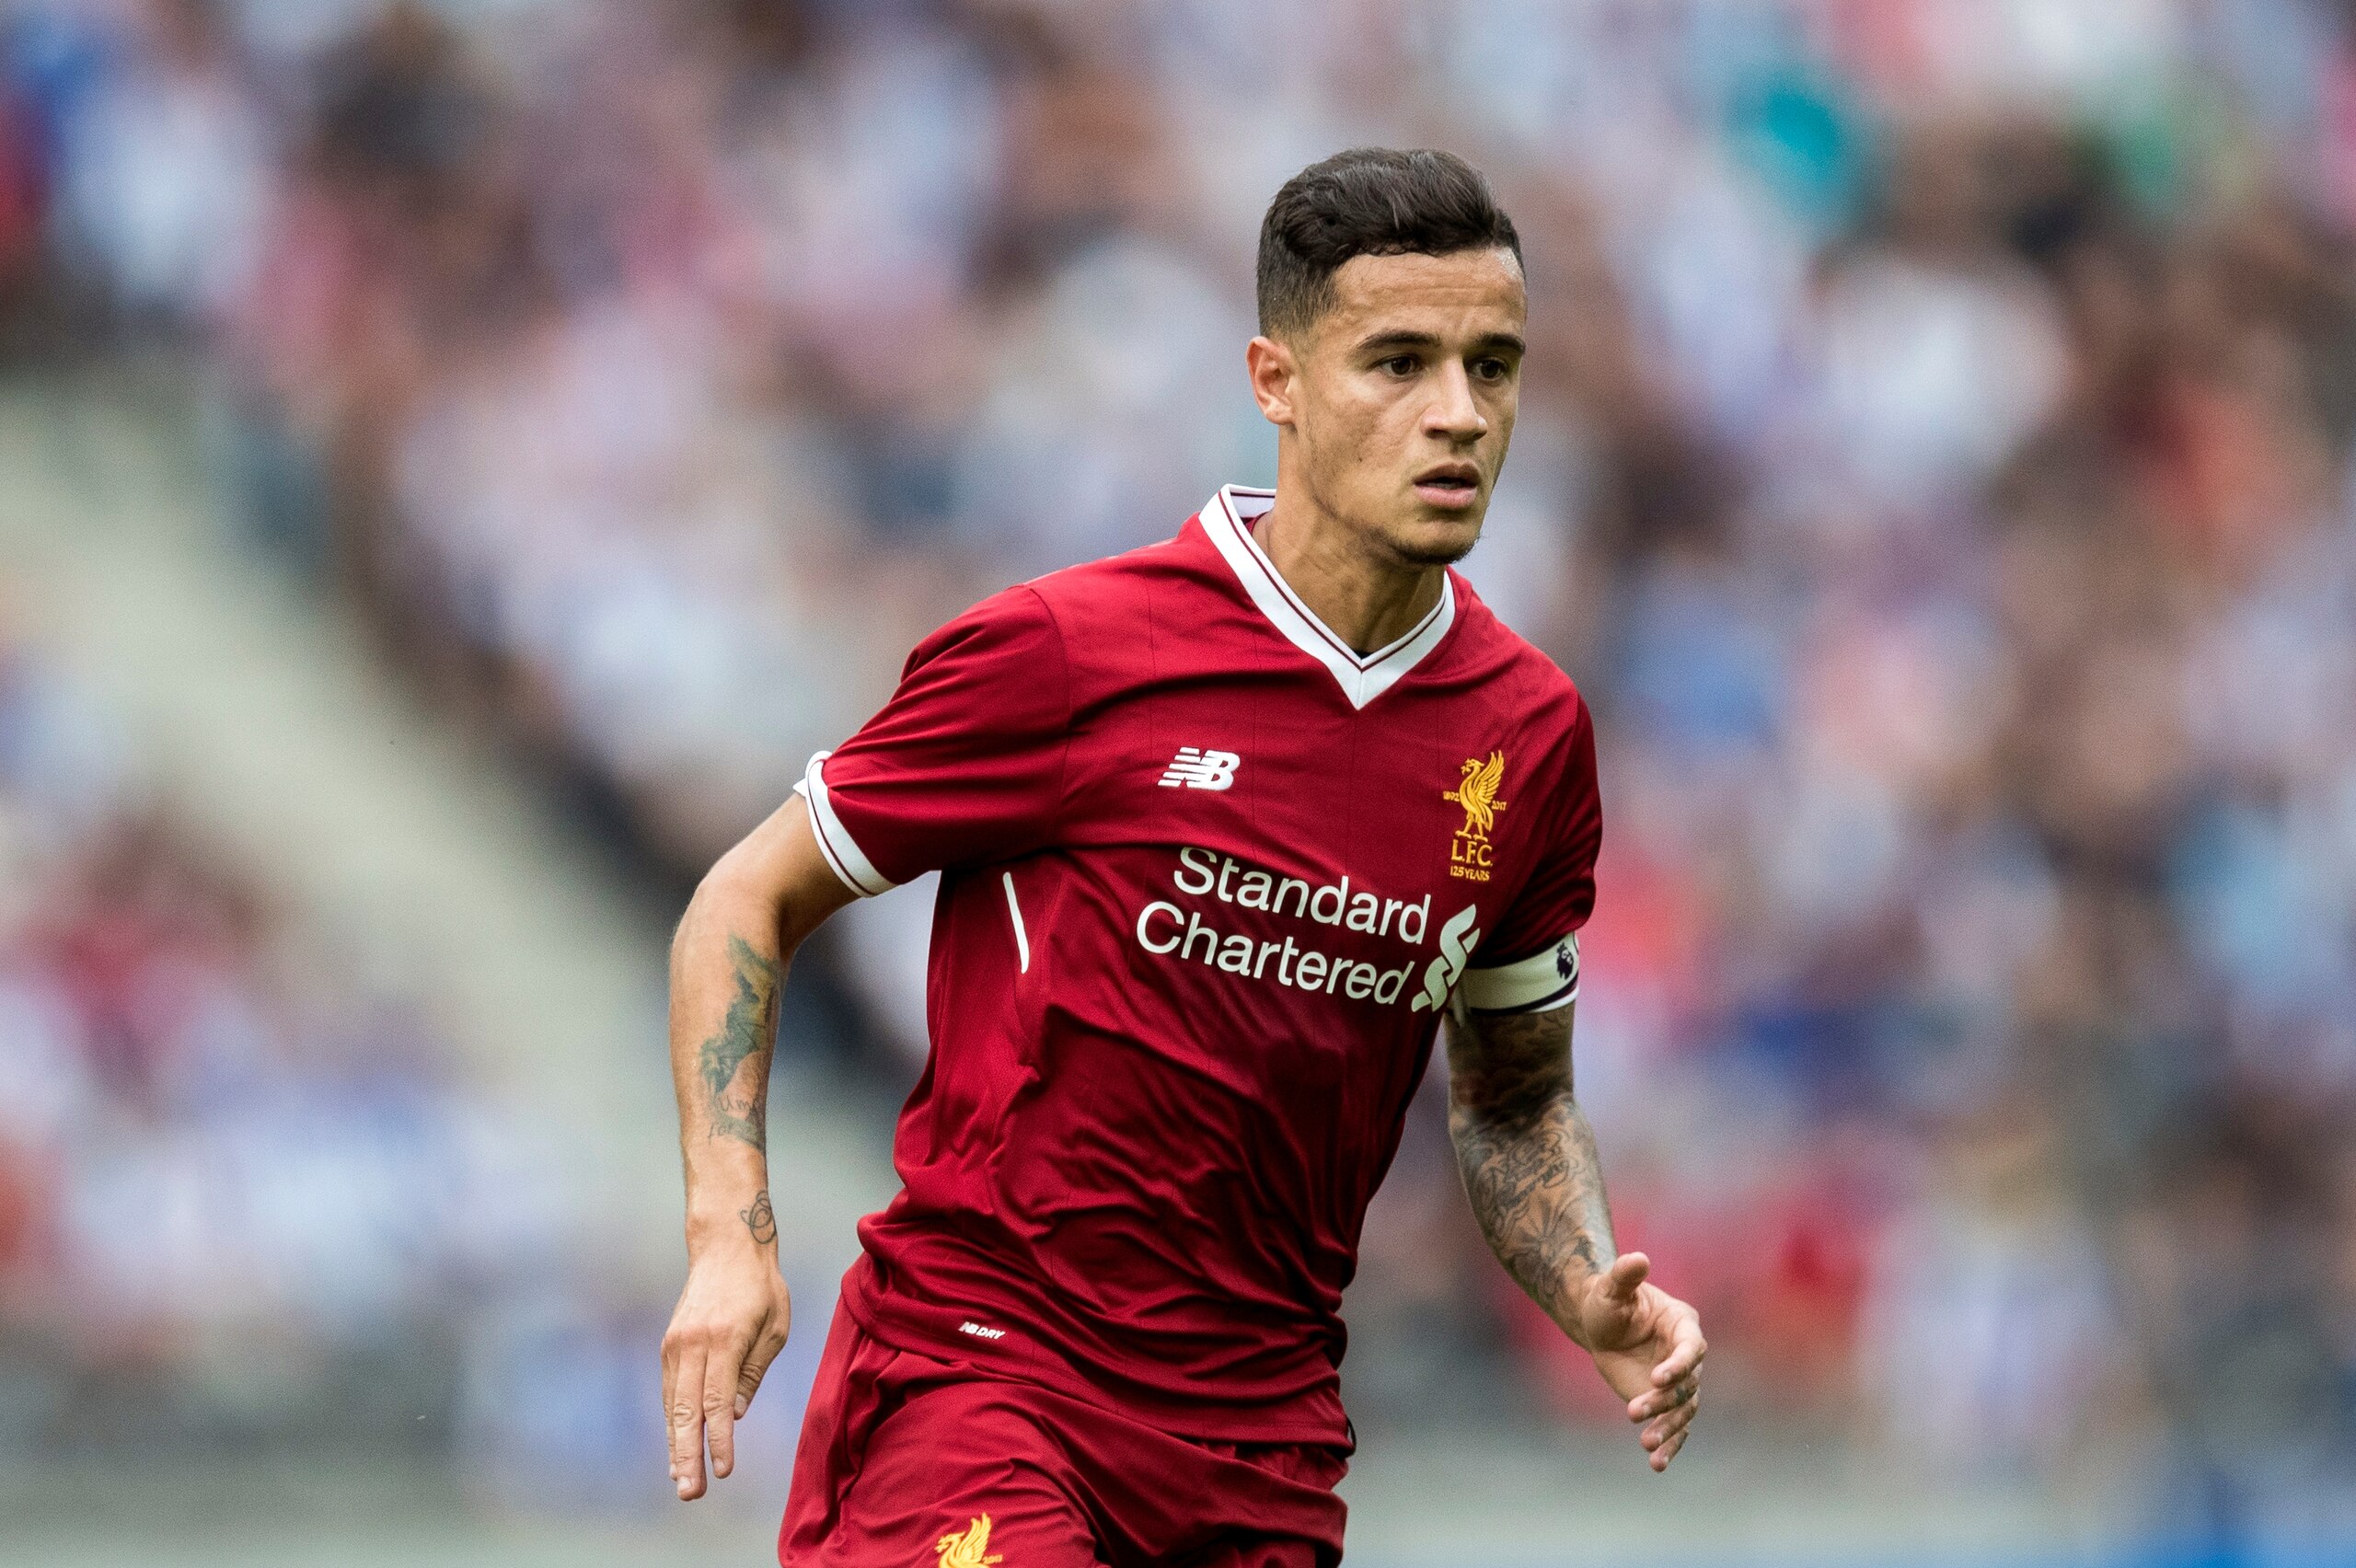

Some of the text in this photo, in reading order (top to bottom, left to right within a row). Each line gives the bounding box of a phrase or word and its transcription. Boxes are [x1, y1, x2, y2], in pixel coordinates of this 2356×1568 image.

[1158, 746, 1241, 791] NB
[1173, 846, 1432, 945] Standard
[1137, 900, 1415, 1005] Chartered
[976, 1327, 1006, 1340] DRY
